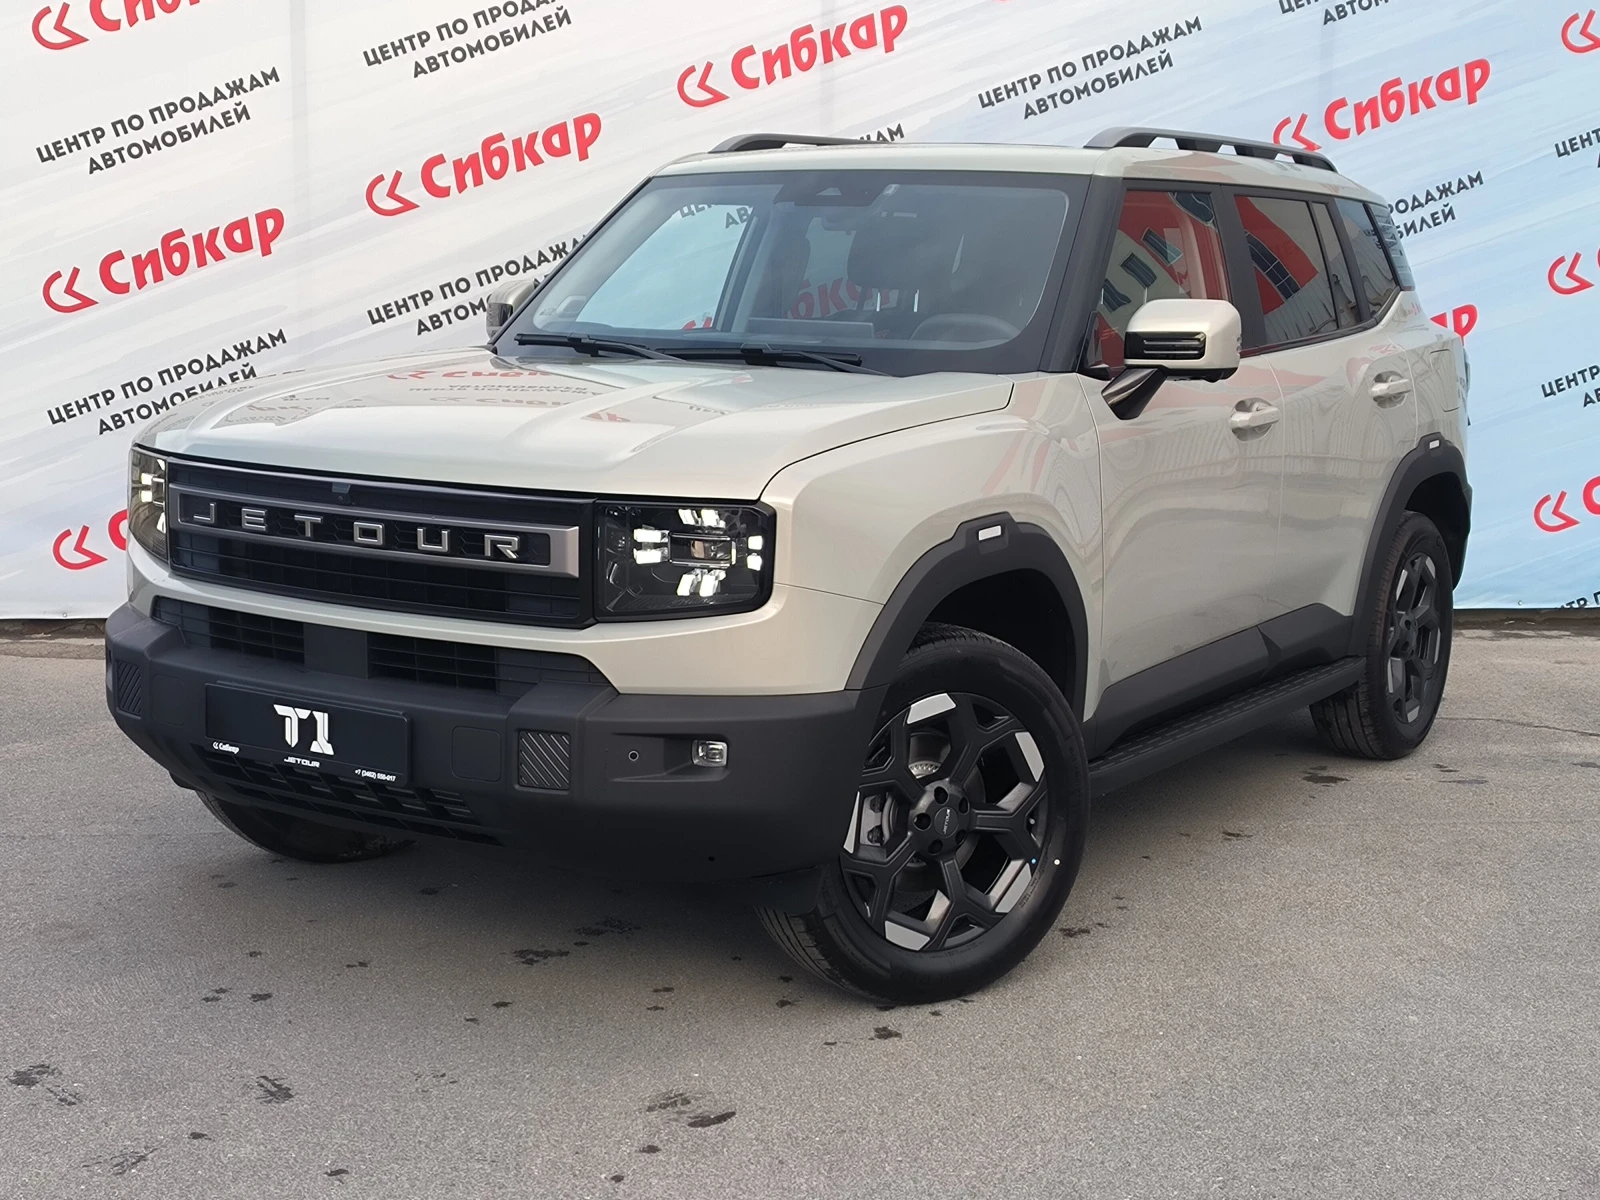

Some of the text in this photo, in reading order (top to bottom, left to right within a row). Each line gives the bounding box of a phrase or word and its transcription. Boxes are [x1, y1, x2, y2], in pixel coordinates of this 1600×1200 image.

[363, 30, 431, 66] ЦЕНТР
[436, 18, 468, 42] ПО
[413, 5, 572, 78] АВТОМОБИЛЕЙ
[731, 5, 908, 90] Сибкар
[978, 16, 1202, 109] ЦЕНТР ПО ПРОДАЖАМ
[36, 66, 280, 163] ЦЕНТР ПО ПРОДАЖАМ
[1023, 48, 1174, 120] АВТОМОБИЛЕЙ
[1324, 58, 1491, 139] Сибкар
[88, 101, 251, 175] АВТОМОБИЛЕЙ
[420, 112, 602, 198] Сибкар
[99, 207, 285, 295] Сибкар
[366, 289, 434, 325] ЦЕНТР
[439, 276, 471, 299] ПО
[47, 328, 287, 425] ЦЕНТР ПО ПРОДАЖАМ
[193, 502, 521, 560] JETOUR
[273, 704, 334, 756] T1
[283, 756, 320, 768] JETOUR
